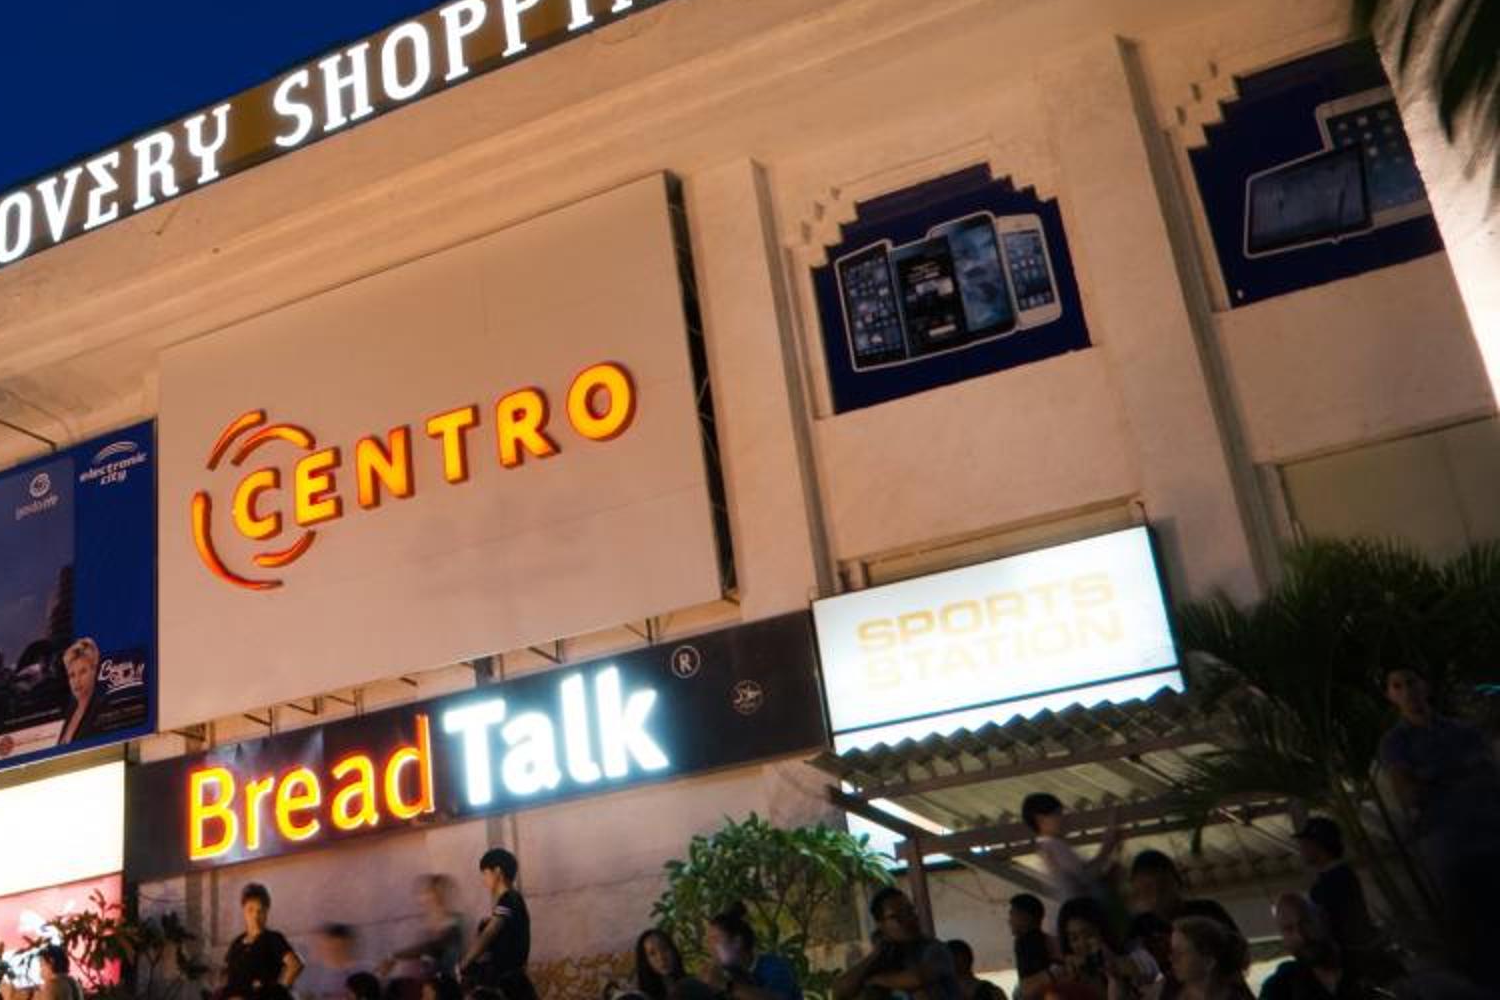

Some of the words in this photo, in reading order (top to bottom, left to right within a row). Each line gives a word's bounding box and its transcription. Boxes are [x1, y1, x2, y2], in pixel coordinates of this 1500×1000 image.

[232, 360, 638, 541] CENTRO
[856, 570, 1116, 653] SPORTS
[865, 608, 1125, 692] STATION
